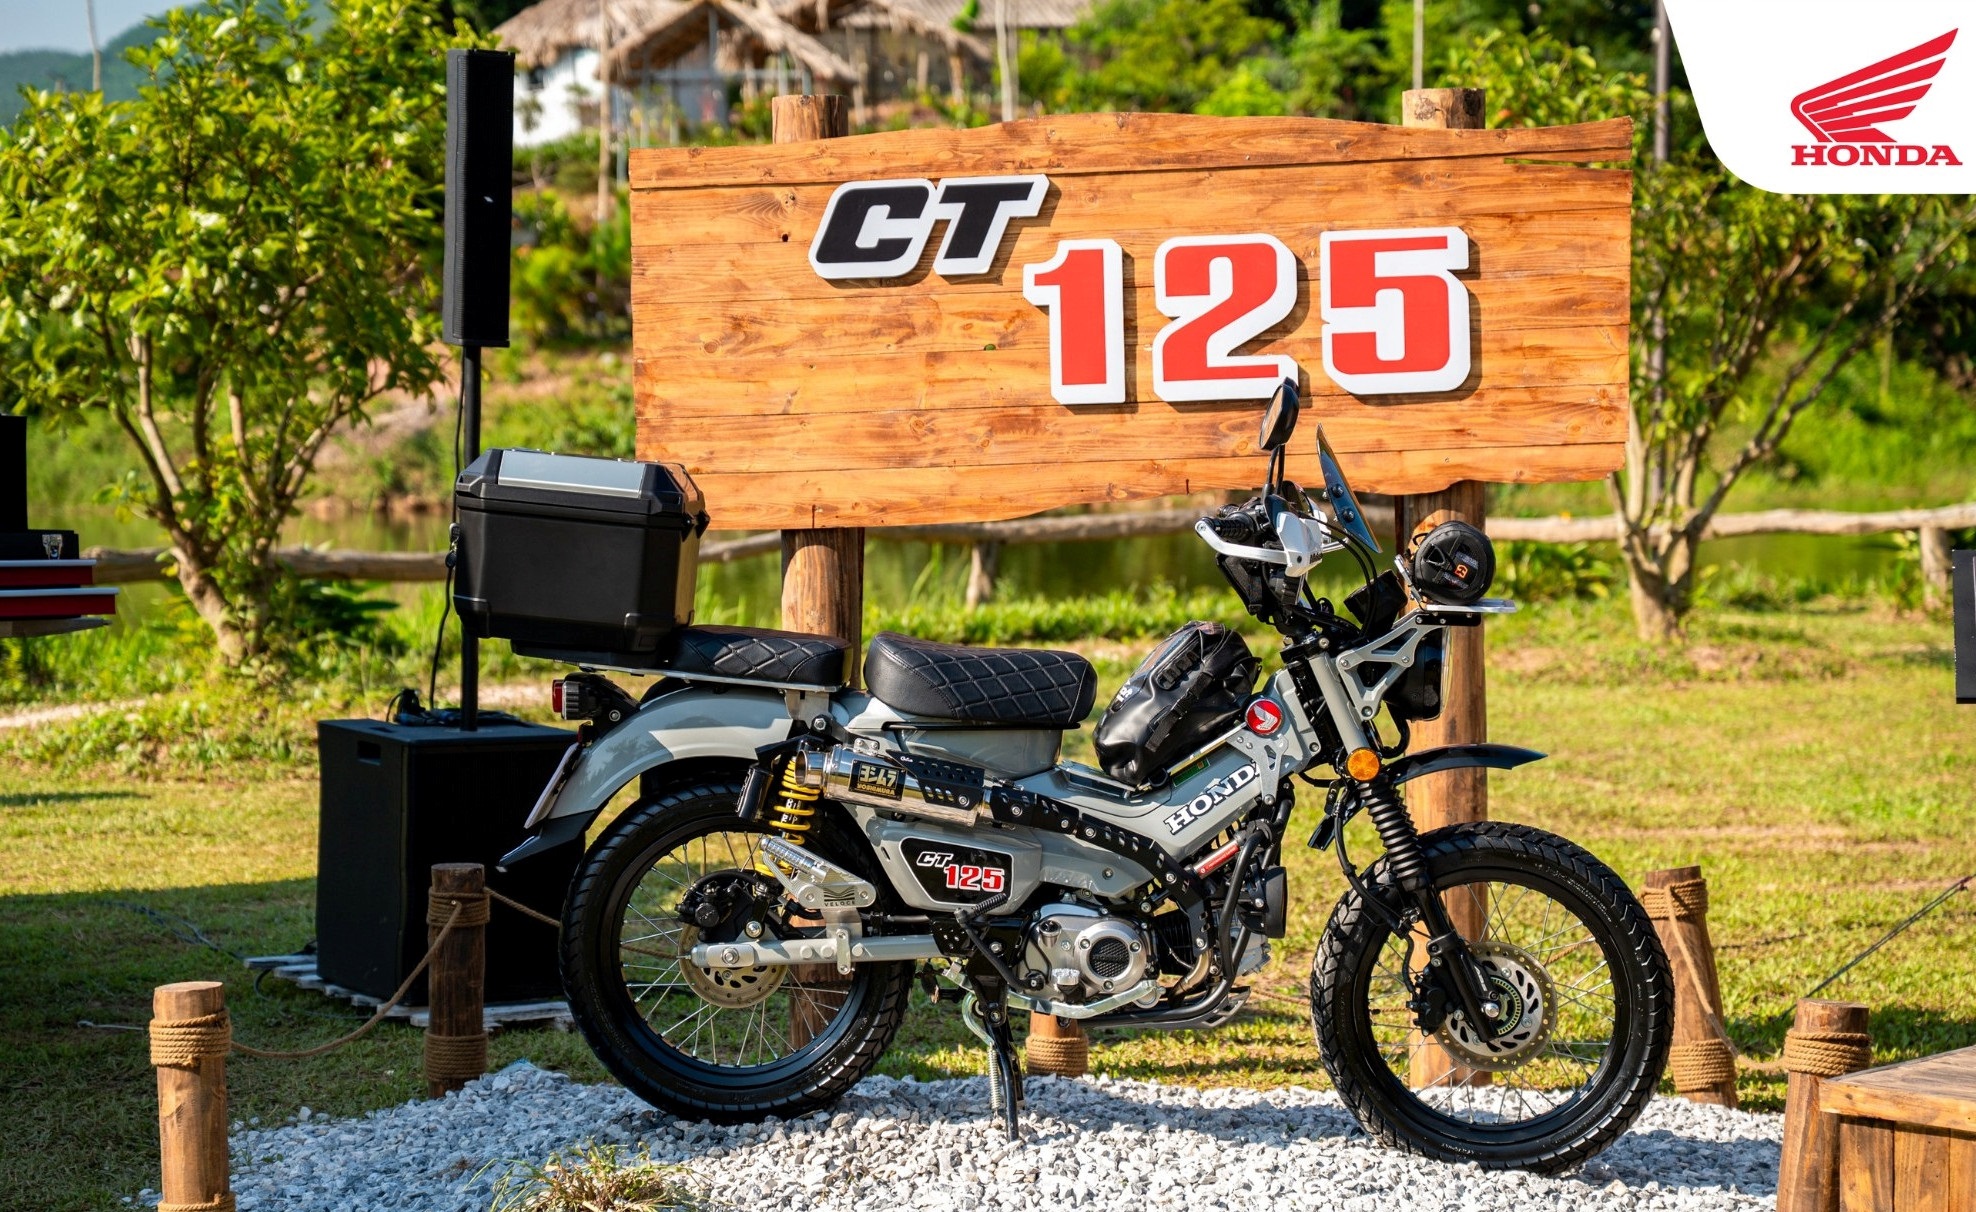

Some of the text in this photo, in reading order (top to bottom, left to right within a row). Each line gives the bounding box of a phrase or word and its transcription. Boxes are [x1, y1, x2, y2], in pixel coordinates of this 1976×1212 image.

[809, 174, 1050, 278] CT
[1024, 226, 1470, 404] 125
[860, 764, 897, 788] ヨシムラ
[916, 851, 954, 868] CT
[943, 864, 1005, 893] 125
